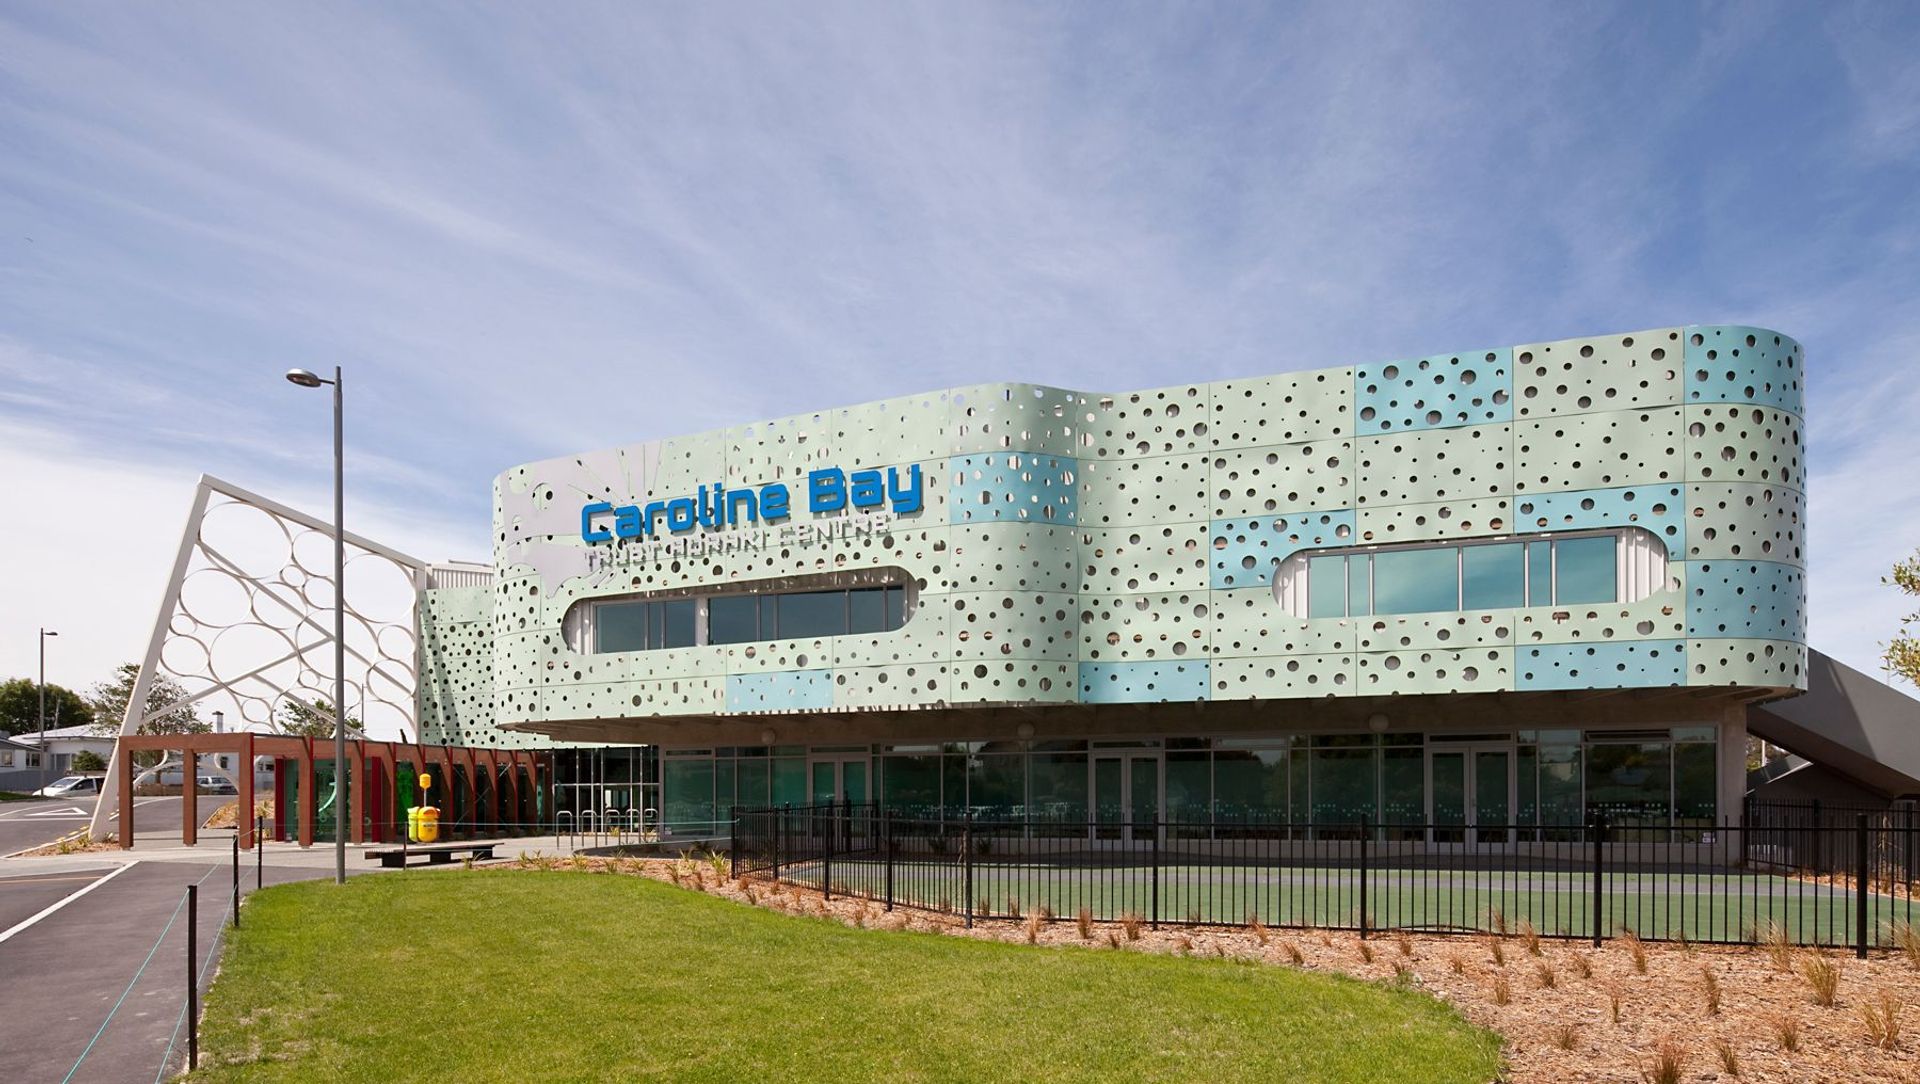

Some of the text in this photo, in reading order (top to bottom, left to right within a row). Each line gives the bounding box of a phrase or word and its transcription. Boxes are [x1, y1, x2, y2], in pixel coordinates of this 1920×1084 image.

[582, 464, 921, 542] Caroline Bay
[582, 537, 662, 571] TRUST
[779, 513, 891, 547] CENTRE
